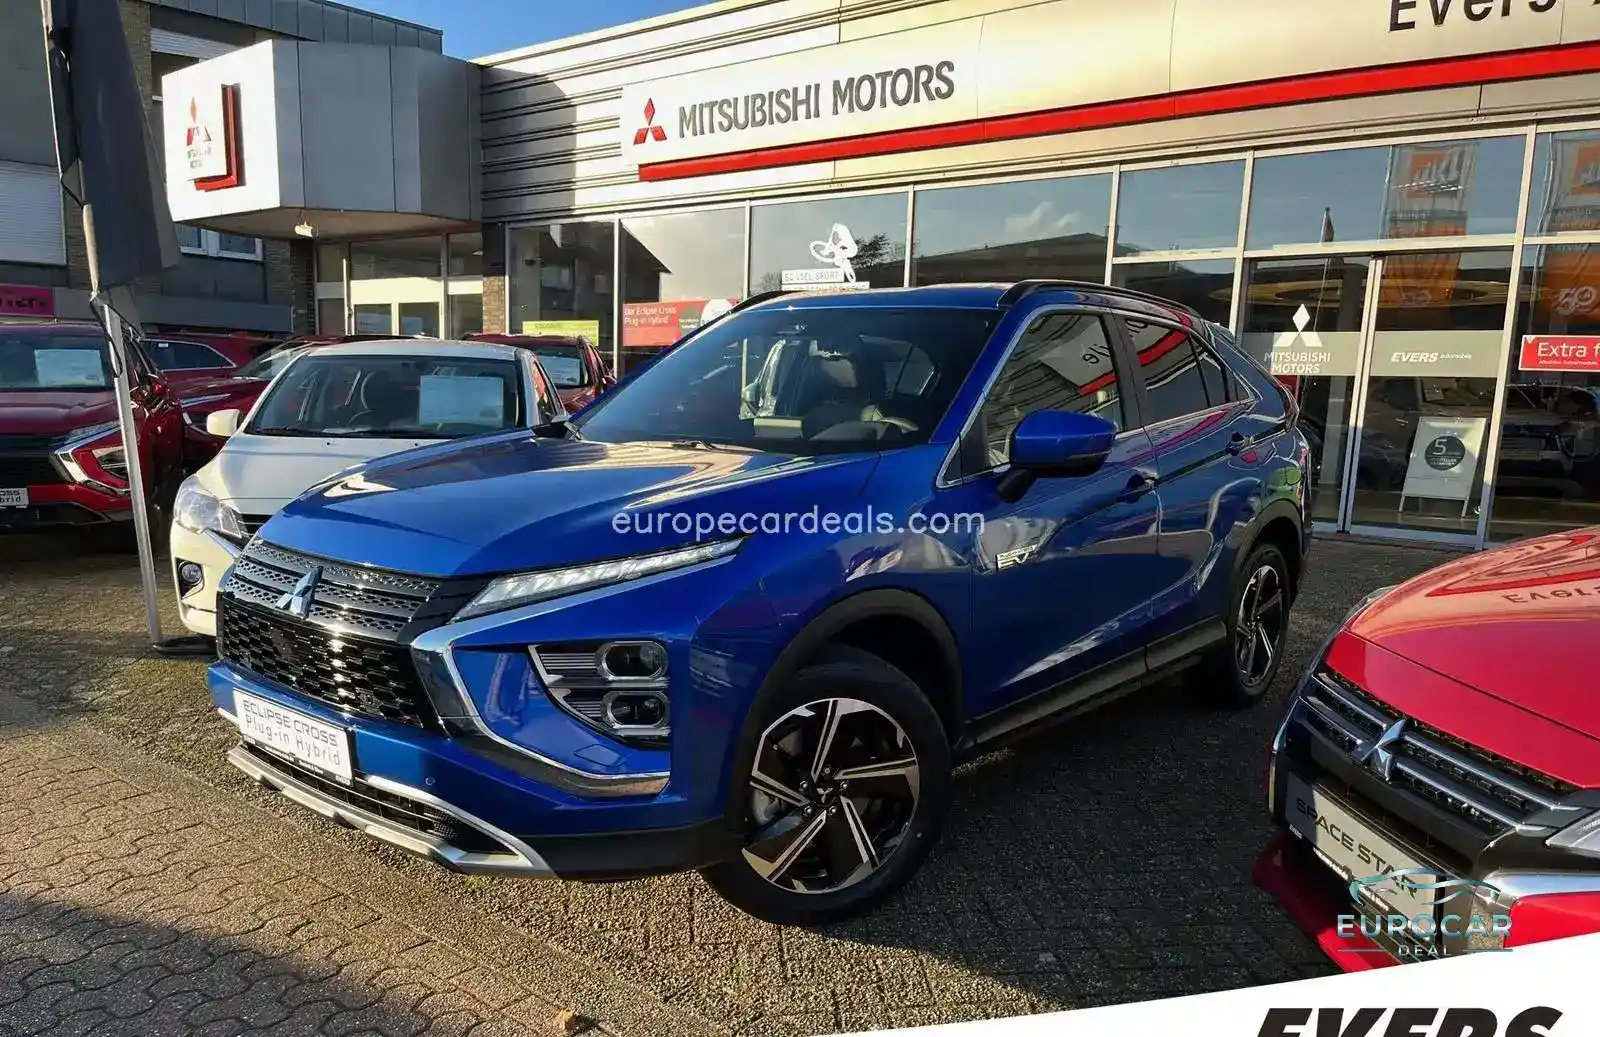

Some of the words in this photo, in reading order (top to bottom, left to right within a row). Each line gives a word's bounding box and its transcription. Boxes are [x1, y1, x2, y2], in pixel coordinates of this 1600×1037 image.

[678, 83, 821, 139] MITSUBISHI
[832, 60, 955, 116] MOTORS
[815, 270, 840, 281] SPORT
[1264, 351, 1331, 362] MITSUBISHI
[1390, 352, 1439, 363] EVERS
[1537, 342, 1587, 358] Extra
[1272, 363, 1320, 374] MOTORS
[1432, 439, 1448, 455] 5
[243, 699, 291, 728] ECLIPSE
[293, 719, 338, 747] CROSS
[245, 714, 290, 743] Plug-in
[295, 734, 340, 766] Hybrid
[1296, 797, 1355, 853] SPACE
[1357, 843, 1418, 900] STAR
